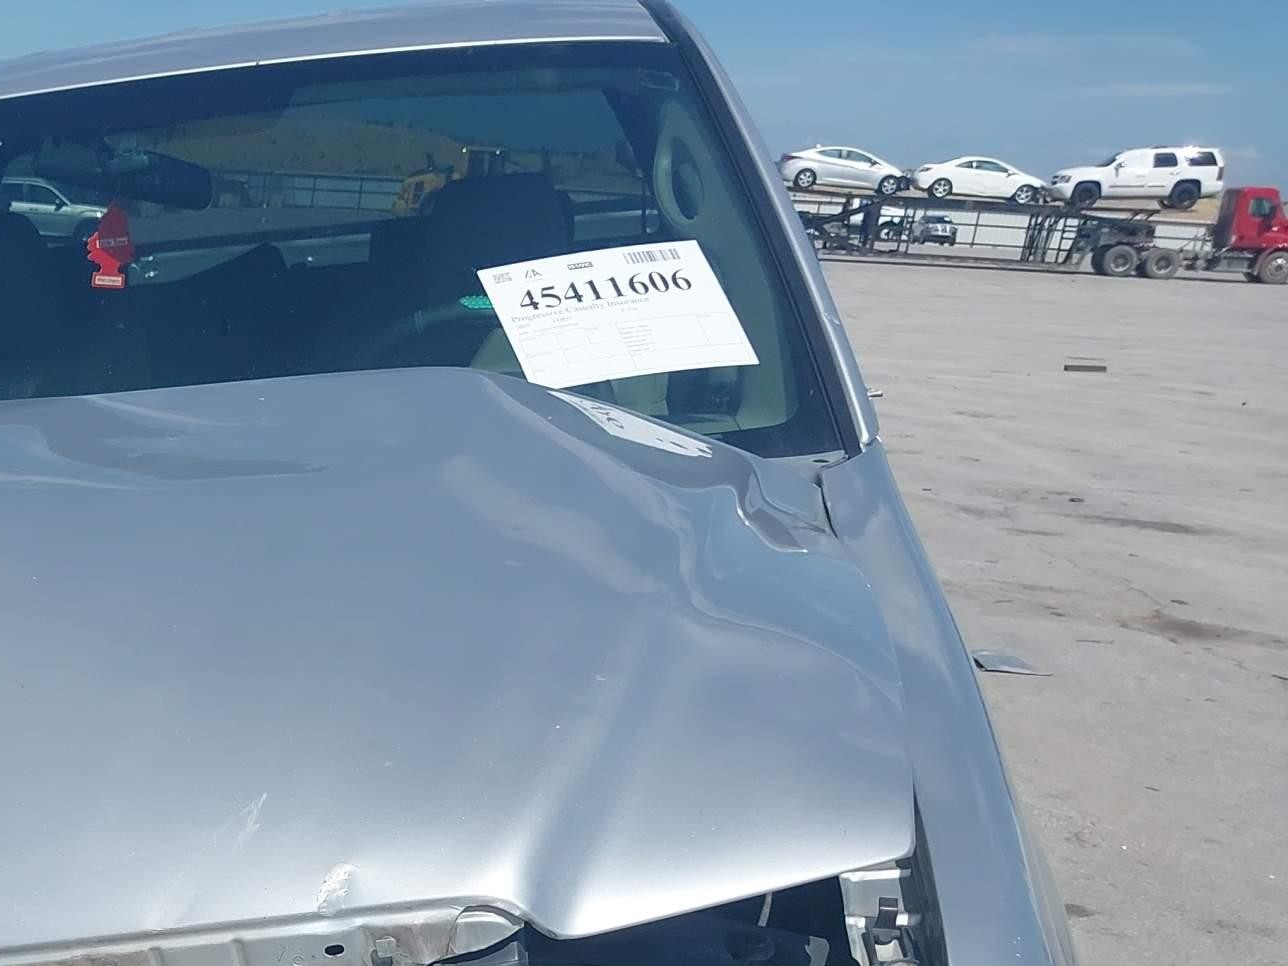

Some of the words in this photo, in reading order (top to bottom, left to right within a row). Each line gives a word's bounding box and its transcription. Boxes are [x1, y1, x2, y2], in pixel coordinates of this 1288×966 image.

[519, 268, 693, 311] 45411606
[511, 306, 565, 323] Progressive
[565, 301, 605, 315] Casualty
[606, 296, 651, 309] Insurance
